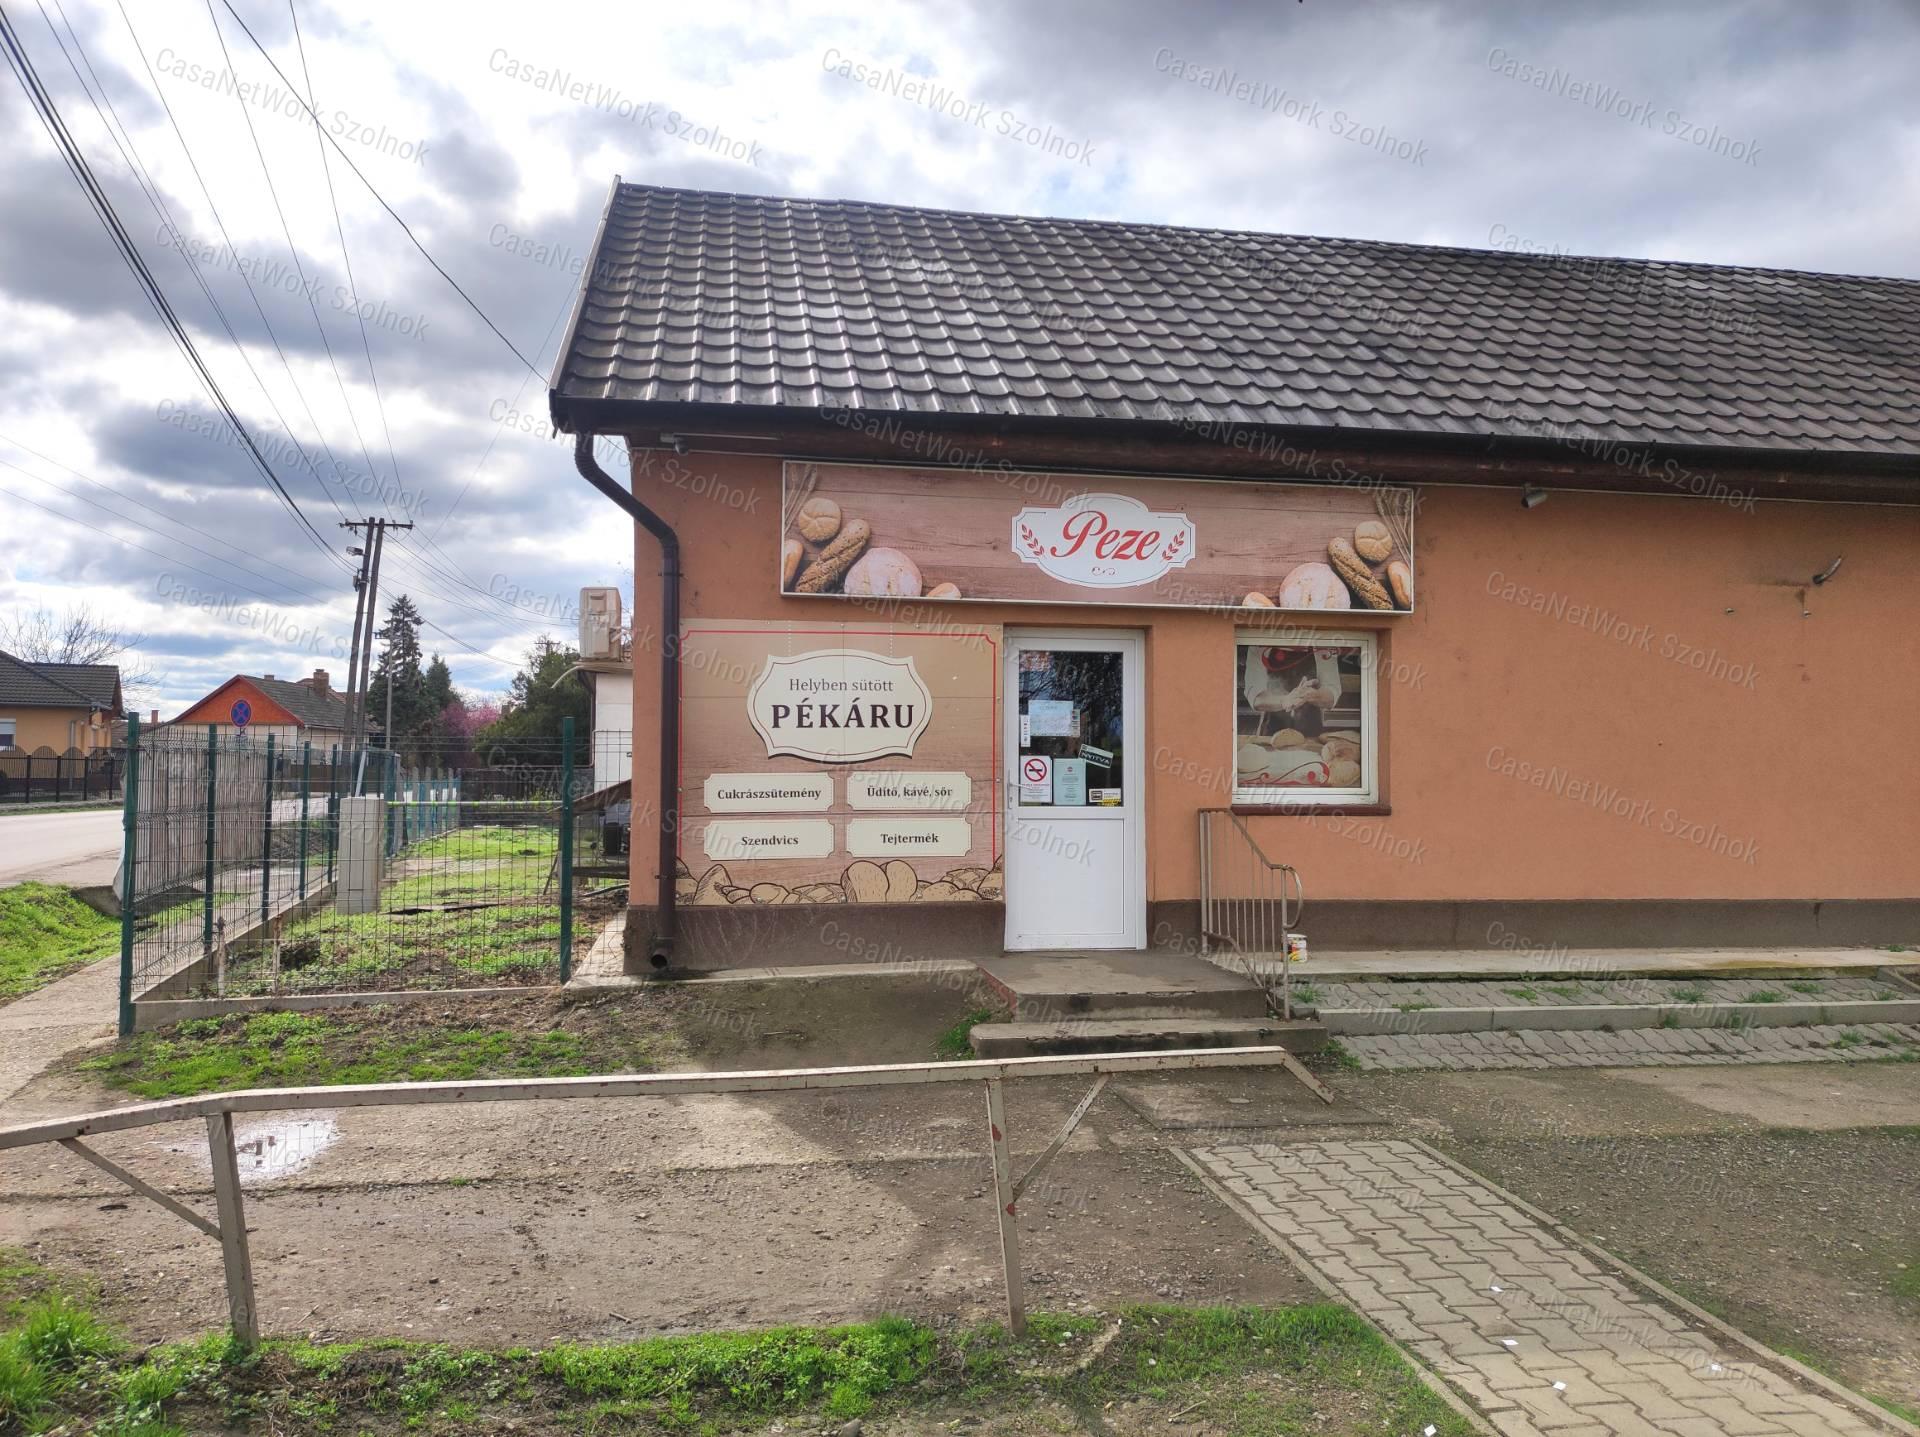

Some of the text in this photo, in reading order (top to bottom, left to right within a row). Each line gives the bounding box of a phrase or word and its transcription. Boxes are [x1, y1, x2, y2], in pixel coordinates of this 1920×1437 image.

[1050, 510, 1160, 560] Peze
[789, 678, 893, 694] Helyben sütött
[771, 697, 914, 728] PÉKÁRU
[1081, 751, 1110, 766] NYITVA
[717, 787, 821, 801] Cukrászsütemény
[867, 785, 953, 798] Üdítő, kávé, sör
[741, 835, 799, 846] Szendvics
[880, 832, 939, 846] Tejtermék
